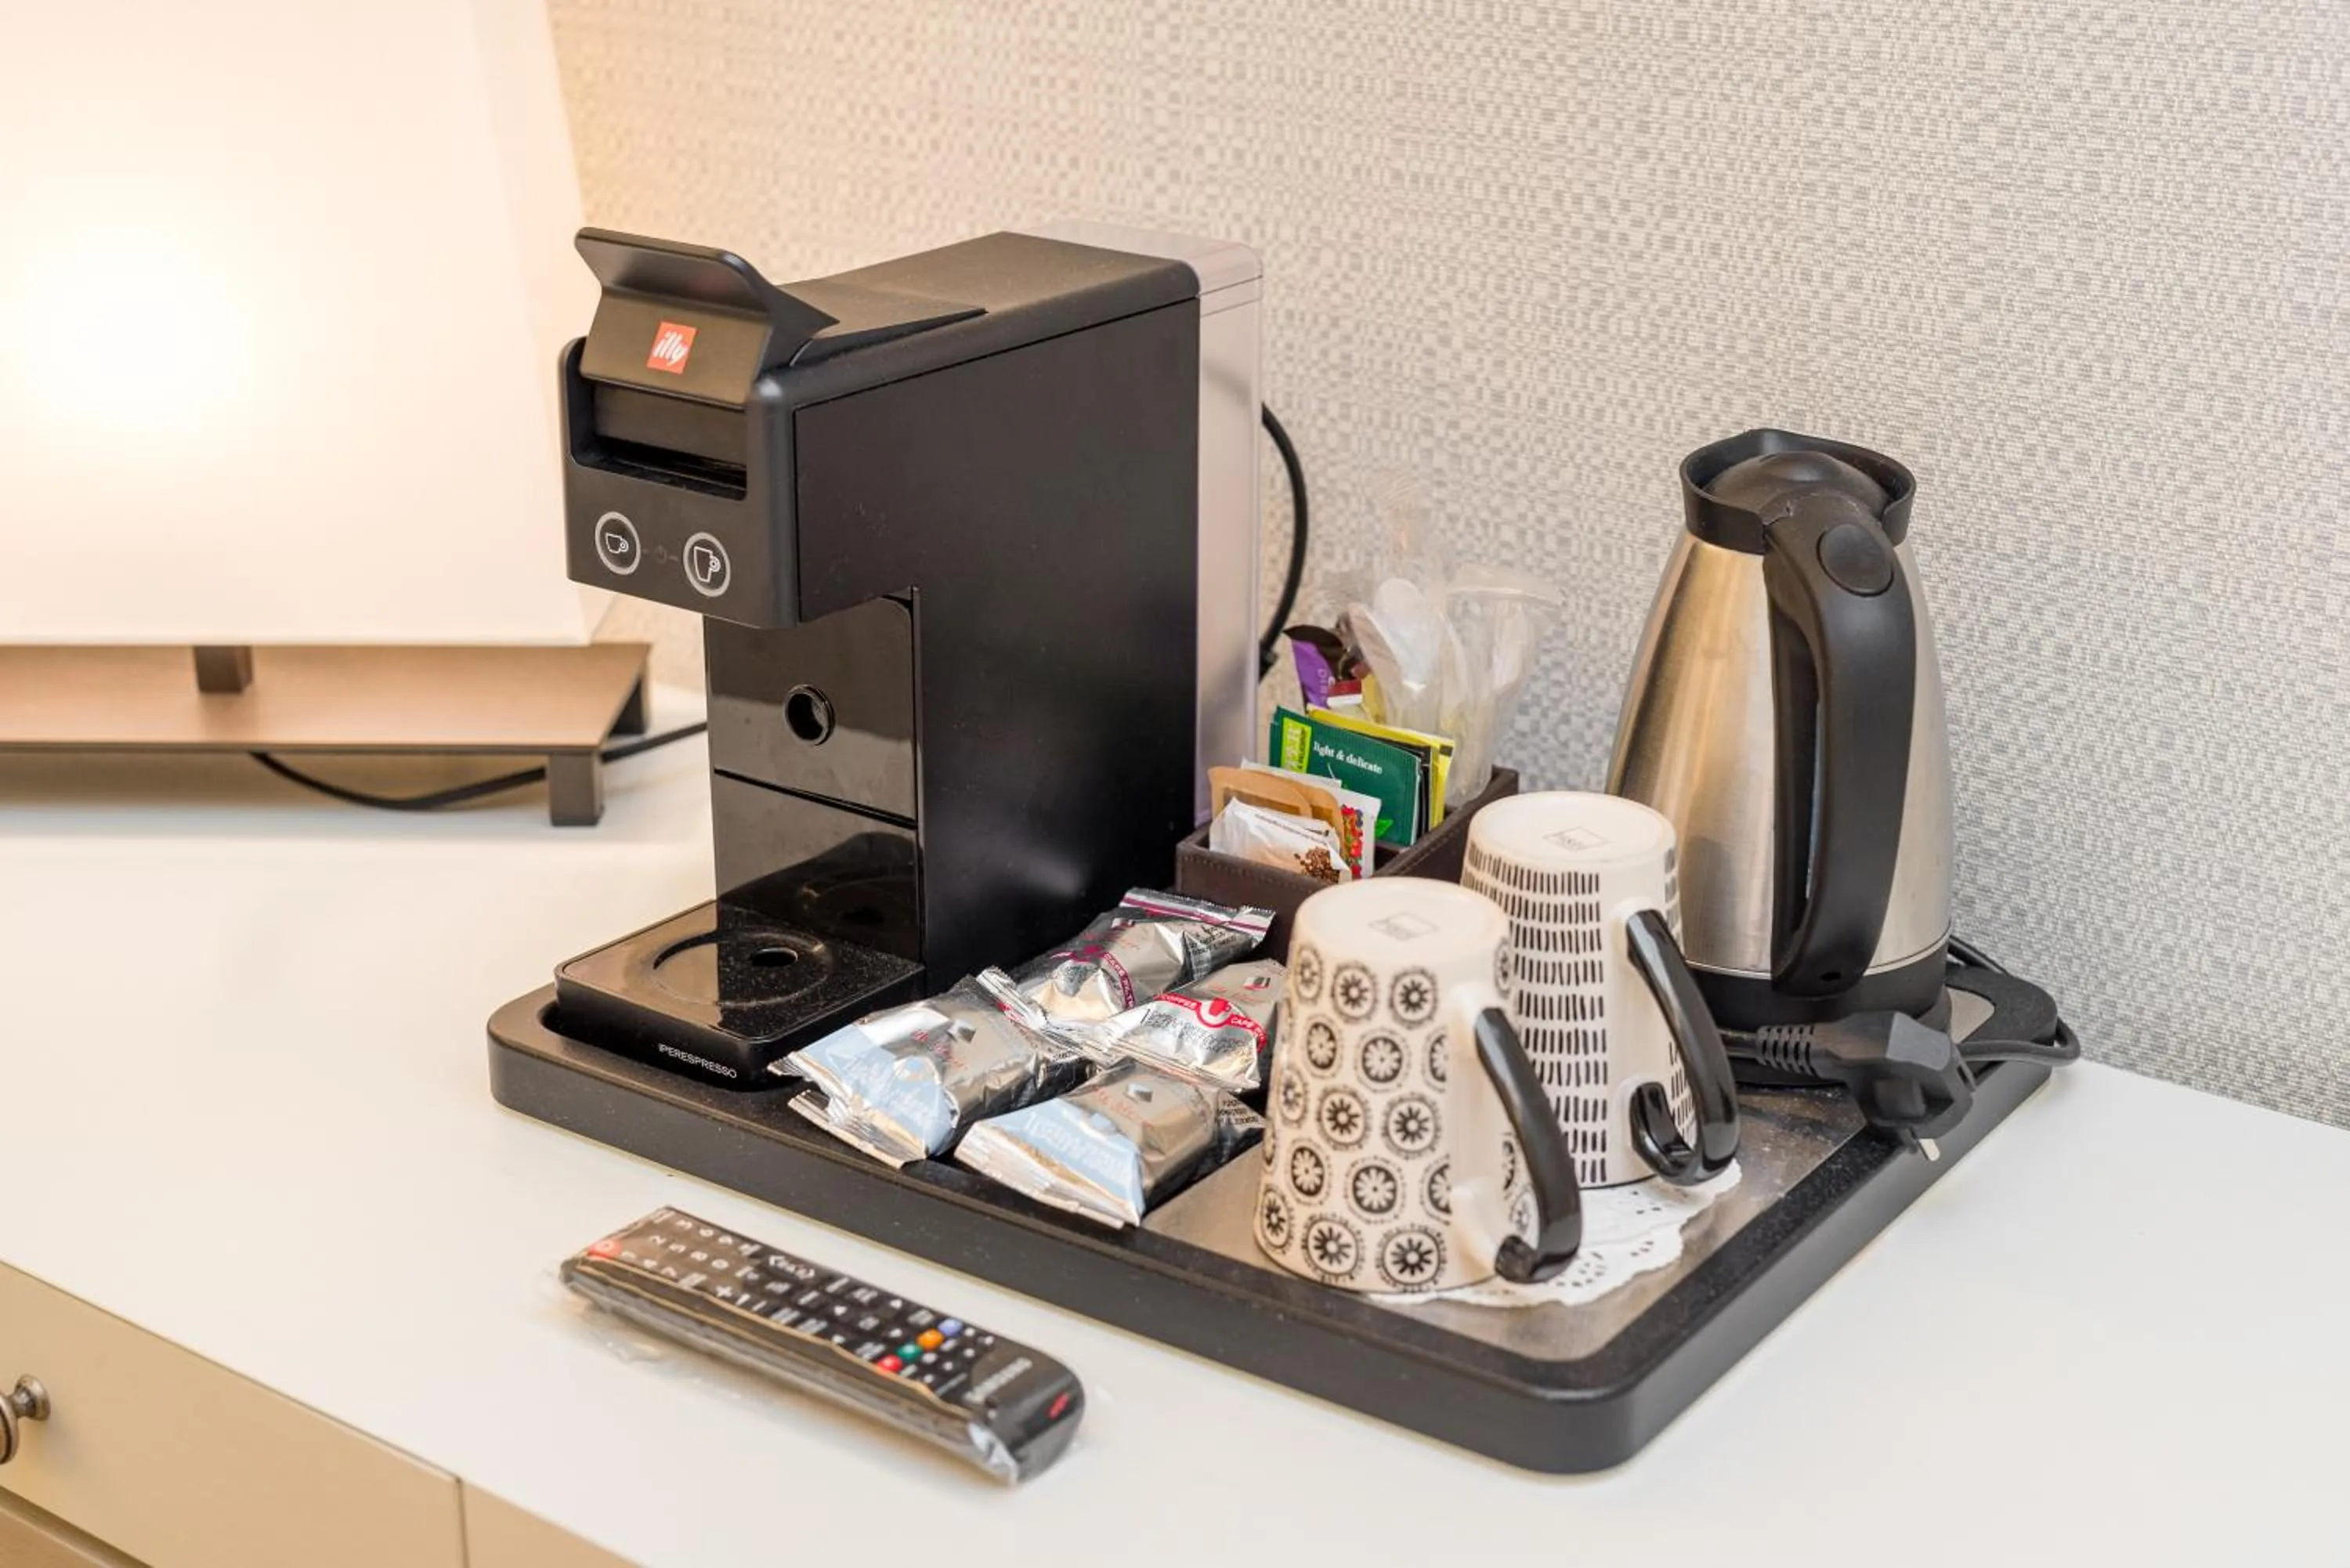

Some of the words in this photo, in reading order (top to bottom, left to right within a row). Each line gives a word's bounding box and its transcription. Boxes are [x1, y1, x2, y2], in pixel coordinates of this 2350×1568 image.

[653, 330, 689, 367] illy
[1336, 749, 1345, 761] &
[1345, 753, 1383, 775] delicate
